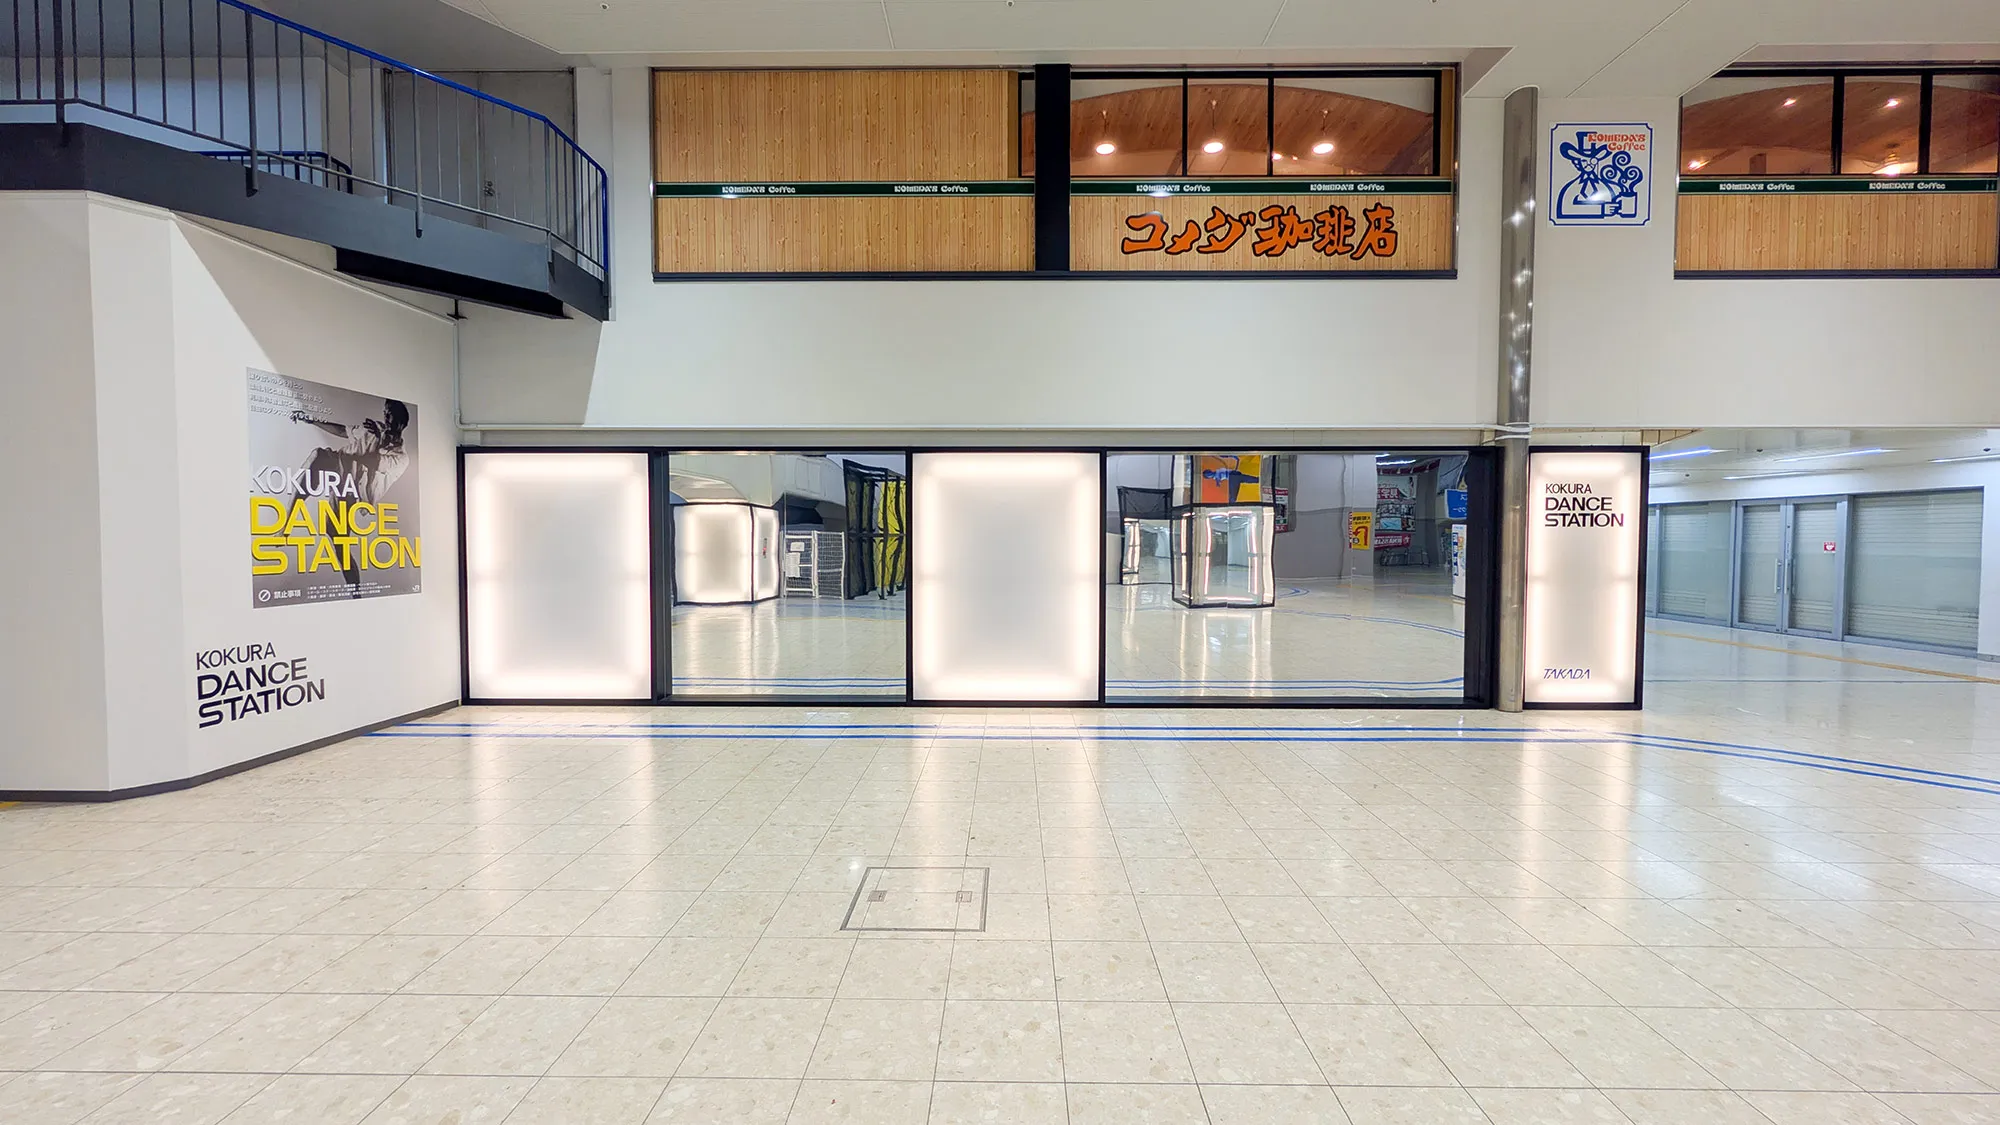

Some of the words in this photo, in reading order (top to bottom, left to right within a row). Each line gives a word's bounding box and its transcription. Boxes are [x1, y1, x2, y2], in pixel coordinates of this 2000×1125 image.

[1588, 134, 1646, 142] KOMEDA'S
[1608, 142, 1646, 151] Coffee
[941, 185, 969, 193] Coffee
[1183, 184, 1211, 192] Coffee
[1357, 183, 1385, 191] Coffee
[1121, 202, 1398, 260] コメダ珈琲店
[250, 464, 359, 499] KOKURA
[1545, 483, 1592, 494] KOKURA
[1545, 497, 1613, 511] DANCE
[250, 497, 400, 536] DANCE
[1545, 513, 1624, 527] STATION
[251, 536, 421, 575] STATION
[196, 642, 276, 670] KOKURA
[197, 657, 308, 700] DANCE
[1543, 668, 1590, 679] TAKADA
[198, 679, 325, 729] STATION
